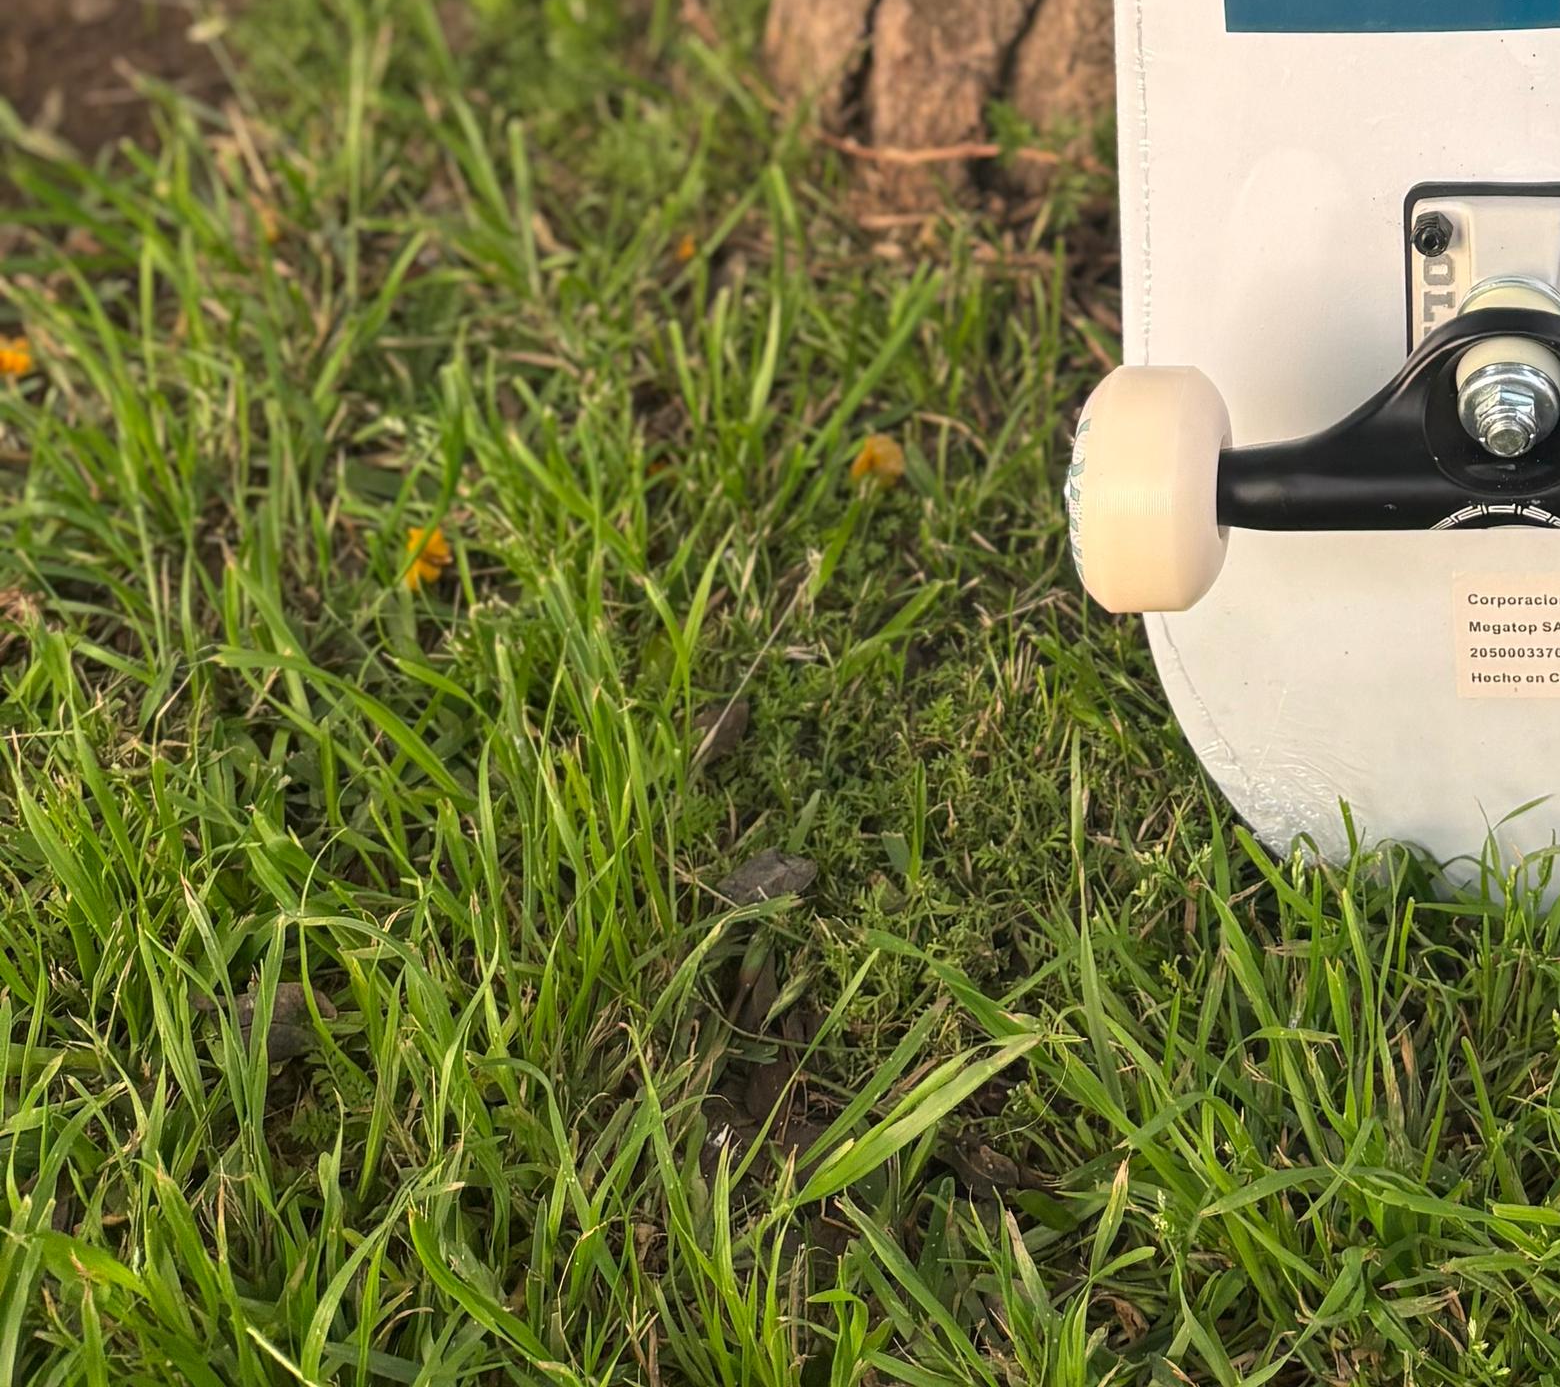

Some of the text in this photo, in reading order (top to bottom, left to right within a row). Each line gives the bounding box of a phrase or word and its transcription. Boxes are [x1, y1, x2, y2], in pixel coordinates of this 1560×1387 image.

[1468, 621, 1538, 635] Megatop
[1471, 672, 1522, 683] Hecho
[1525, 674, 1545, 683] en
